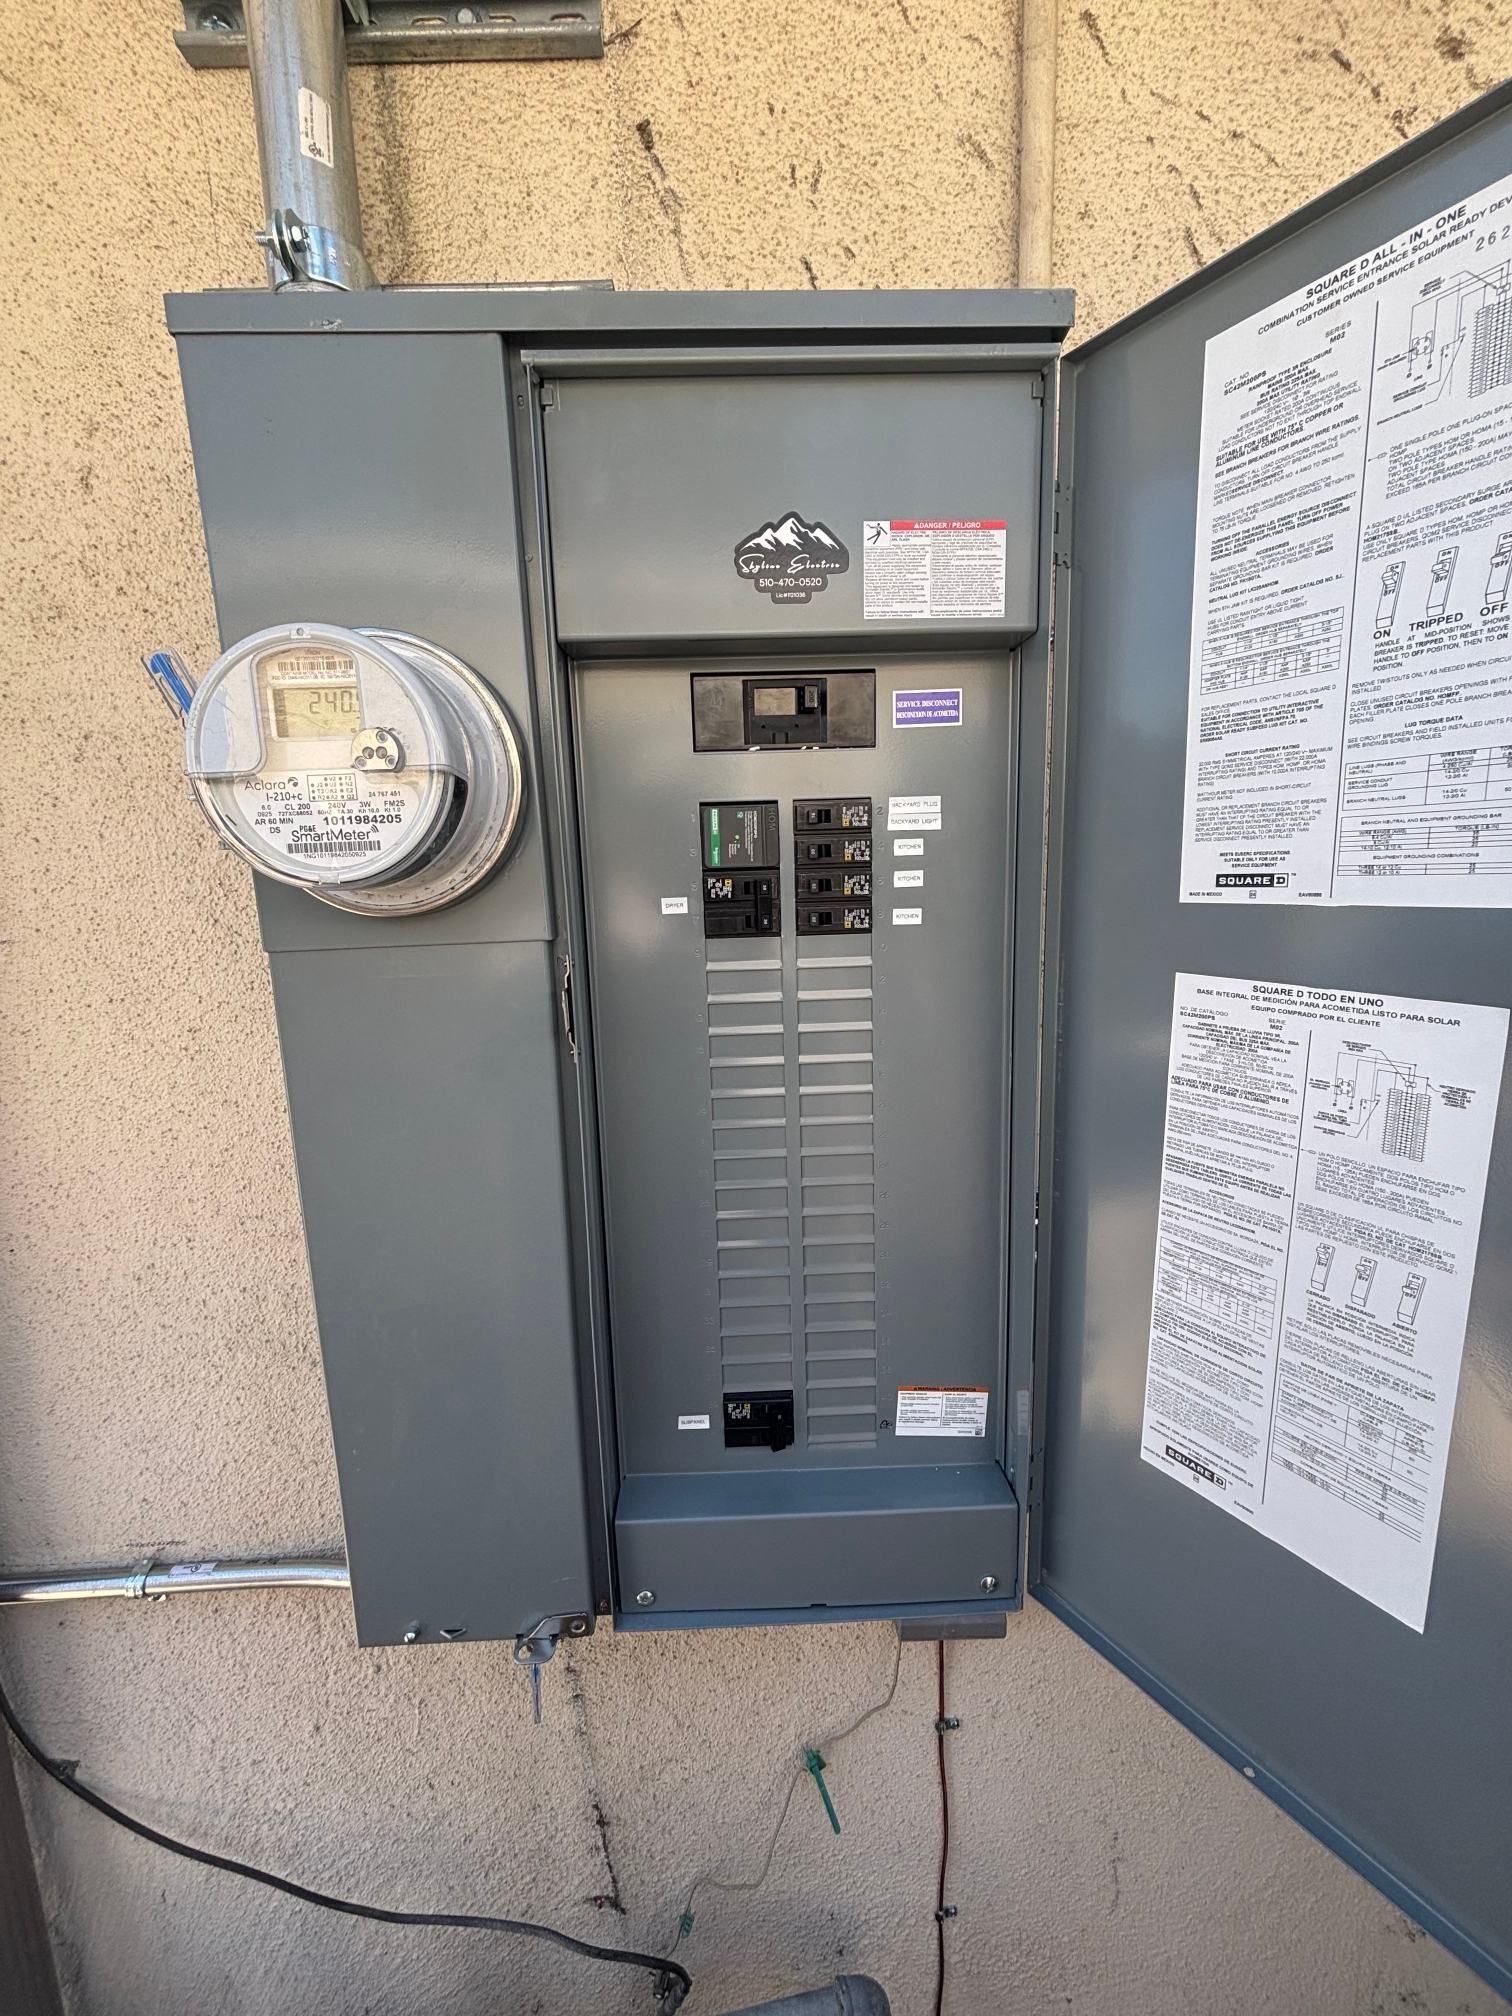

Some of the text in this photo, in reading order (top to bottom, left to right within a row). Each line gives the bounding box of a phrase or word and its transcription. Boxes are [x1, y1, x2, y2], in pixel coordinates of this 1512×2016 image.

[1306, 268, 1356, 299] SQUARE
[1361, 258, 1369, 270] D
[1372, 246, 1397, 265] ALL
[1410, 230, 1423, 244] IN
[1436, 205, 1467, 229] ONE
[1258, 300, 1314, 335] COMBINATION
[1317, 280, 1354, 307] SERVICE
[1357, 253, 1409, 283] ENTRANCE
[1411, 233, 1447, 255] SOLAR
[1450, 209, 1488, 233] READY
[1296, 229, 1475, 326] CUSTOMER OWNED SERVICE EQUIPMENT
[1325, 320, 1352, 338] SERIES
[1329, 331, 1346, 344] M02
[1216, 445, 1243, 462] SUITABLE
[1245, 439, 1256, 450] FOR
[1258, 434, 1269, 444] USE
[1270, 427, 1286, 439] WITH
[1305, 408, 1331, 424] COPPER
[1333, 403, 1343, 413] OR
[1215, 469, 1224, 479] SEE
[1226, 460, 1247, 474] BRANCH
[1248, 448, 1276, 465] BREAKERS
[1278, 443, 1289, 453] FOR
[1290, 433, 1314, 448] BRANCH
[1315, 426, 1330, 438] WIRE
[1216, 450, 1246, 467] ALUMINUM
[1247, 444, 1259, 455] LINE
[759, 578, 822, 586] 510-470-0520
[1373, 602, 1509, 640] ON TRIPPED OFF
[1375, 614, 1510, 648] HANDLE AT MID-POSITION SHOWS
[1373, 653, 1399, 664] HANDLE
[1402, 651, 1410, 659] TO
[1412, 648, 1425, 657] OFF
[1463, 637, 1483, 648] THEN
[1485, 634, 1495, 643] TO
[1497, 631, 1508, 640] ON
[1374, 644, 1404, 656] BREAKER
[1448, 633, 1458, 642] TO
[1487, 623, 1509, 634] MOVE
[1404, 714, 1463, 728] LUG TORQUE DATA
[245, 780, 286, 791] Aclara
[266, 792, 303, 801] I-210+c
[323, 815, 402, 825] 1011984205
[292, 829, 371, 842] SmartMeter
[1219, 877, 1271, 885] SQUARE
[1253, 985, 1383, 1007] SQUARE D TODO EN UNO
[1216, 990, 1249, 1000] INTEGRAL
[1262, 995, 1298, 1006] MEDICIÓN
[1322, 1003, 1370, 1018] ACOMETIDA
[1372, 1010, 1397, 1019] LISTO
[1400, 1014, 1425, 1022] PARA
[1428, 1017, 1461, 1026] SOLAR
[1251, 1005, 1276, 1013] EQUIPO
[1278, 1008, 1318, 1019] COMPRADO
[1348, 1018, 1381, 1027] CLIENTE
[1167, 1448, 1213, 1480] SQUARE
[1215, 1476, 1224, 1487] D
